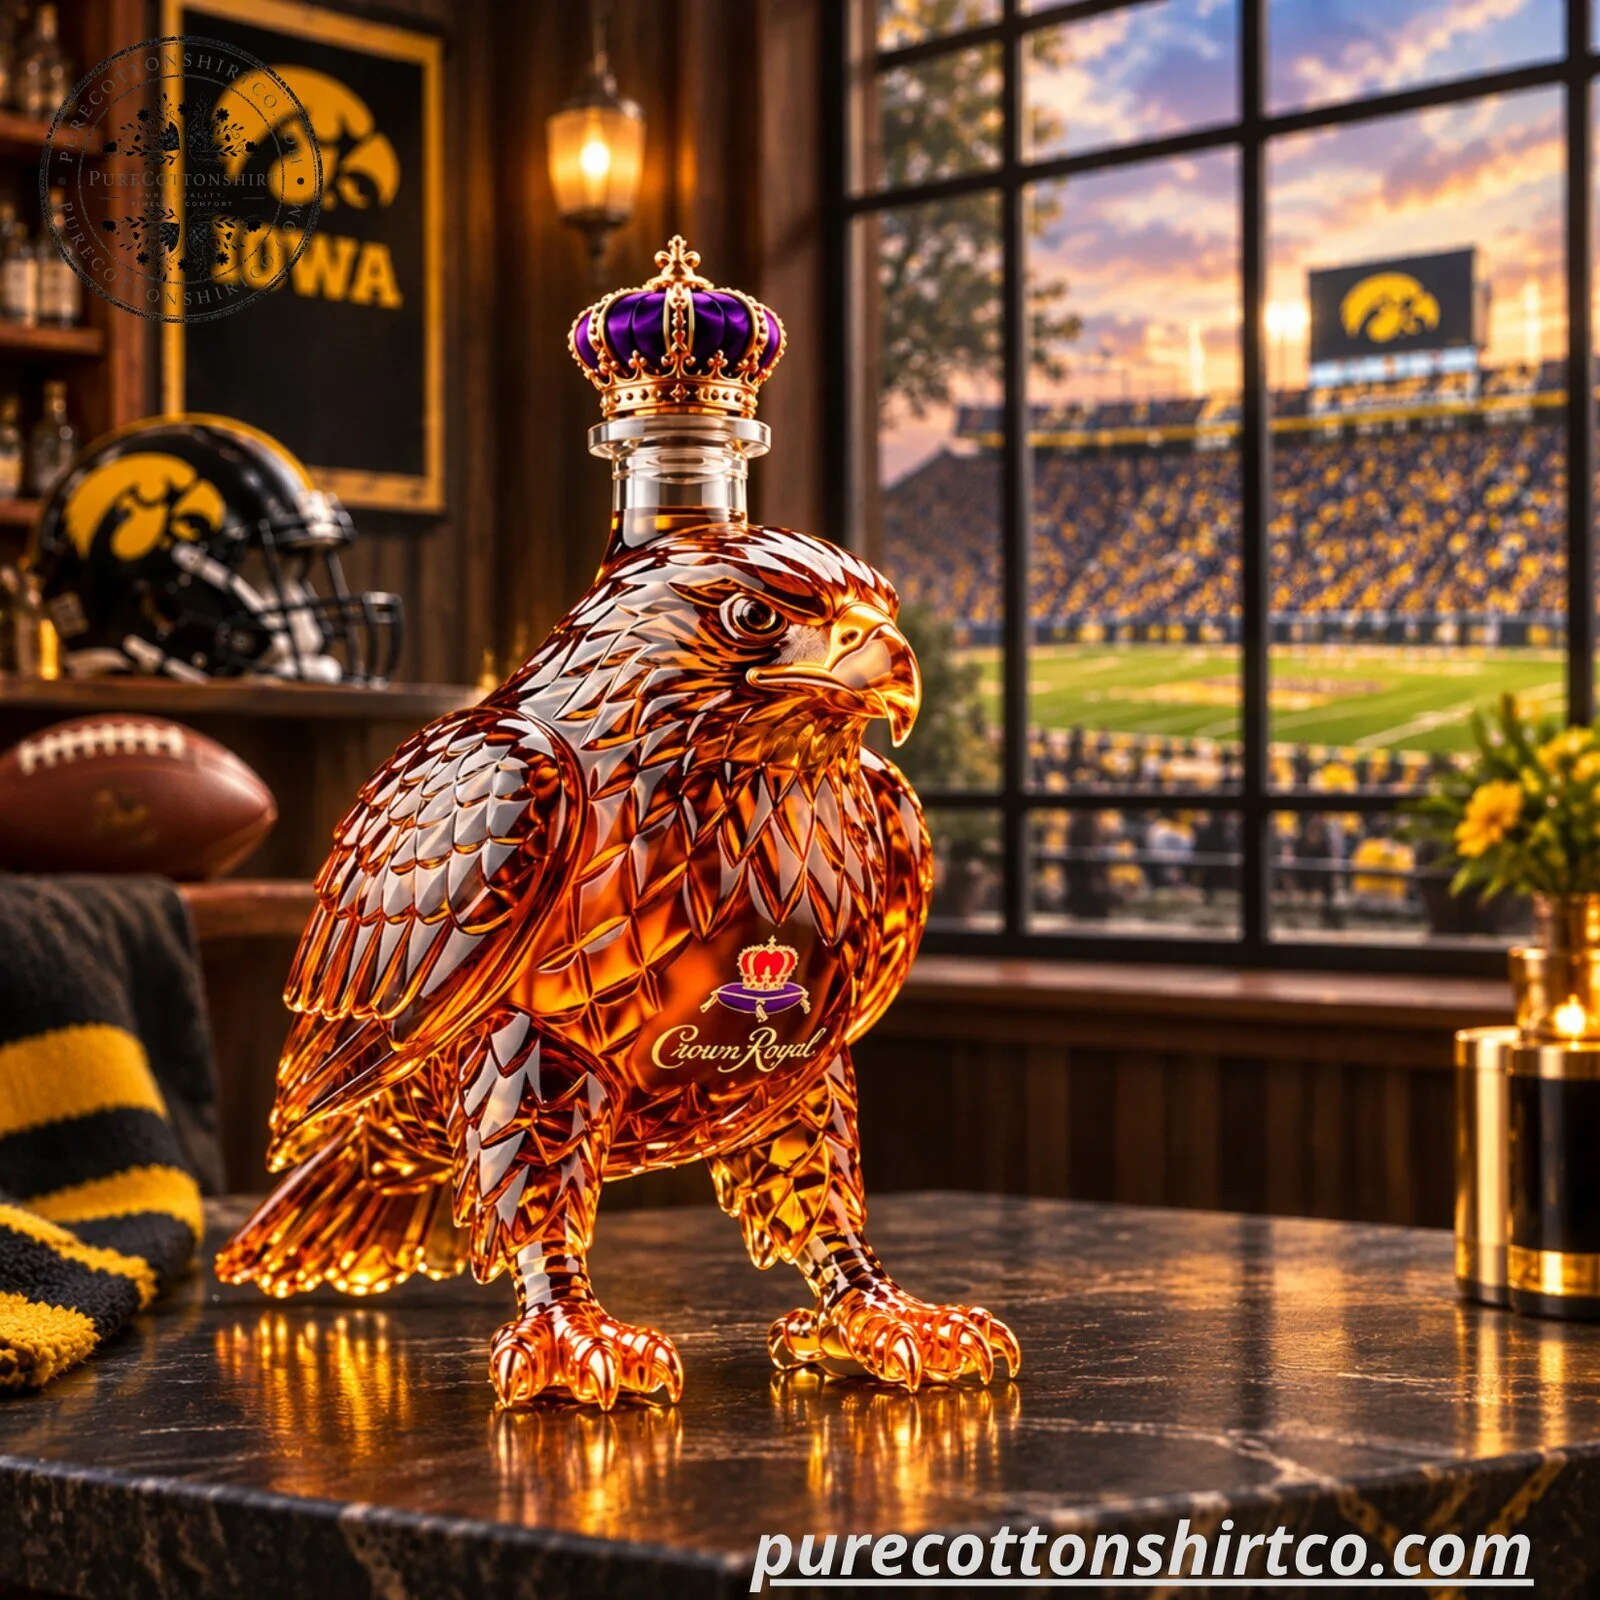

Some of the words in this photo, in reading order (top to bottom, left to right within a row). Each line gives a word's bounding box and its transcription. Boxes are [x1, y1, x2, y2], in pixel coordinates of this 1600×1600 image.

[210, 214, 403, 310] IOWA
[651, 1024, 741, 1070] Crown
[717, 1026, 828, 1073] Royal
